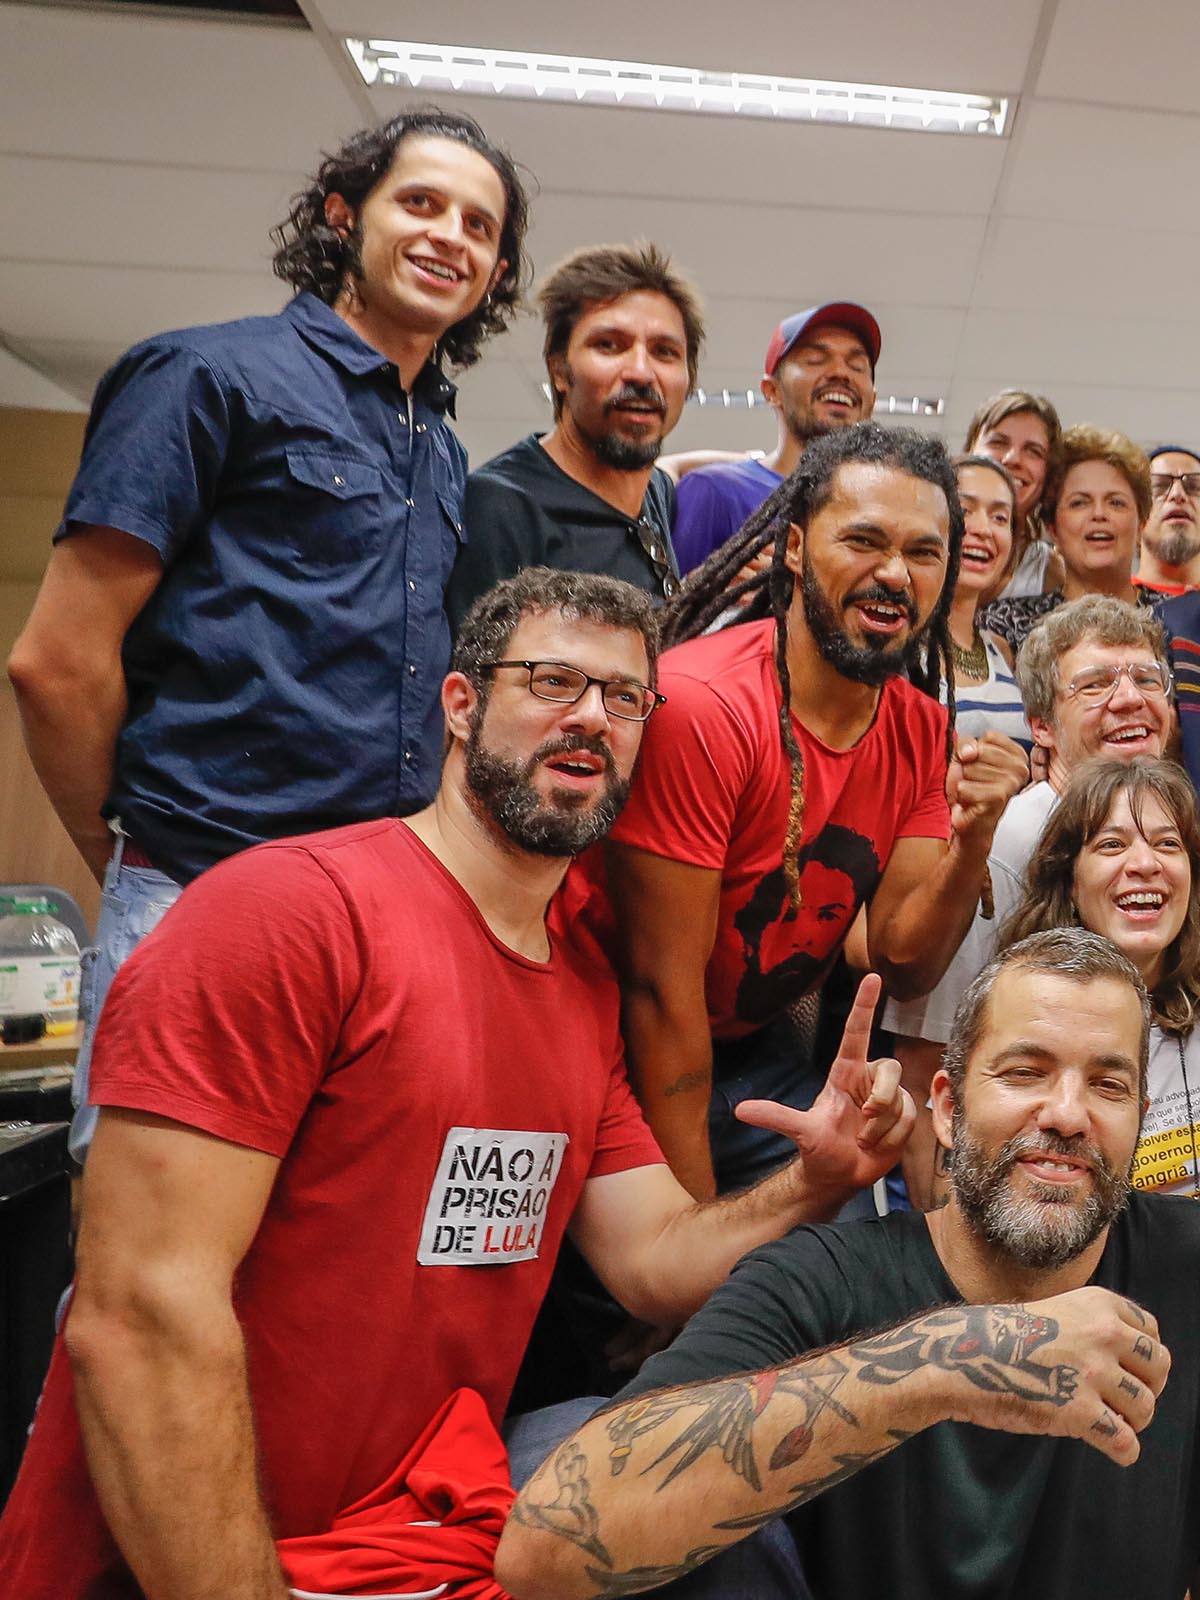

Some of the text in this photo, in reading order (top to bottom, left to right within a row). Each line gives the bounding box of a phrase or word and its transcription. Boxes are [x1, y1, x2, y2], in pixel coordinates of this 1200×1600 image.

[1156, 1107, 1173, 1120] que
[1163, 1118, 1175, 1128] Se
[448, 1139, 555, 1182] NÃO À
[439, 1182, 547, 1219] PRISÃO
[431, 1223, 537, 1254] DE LULA
